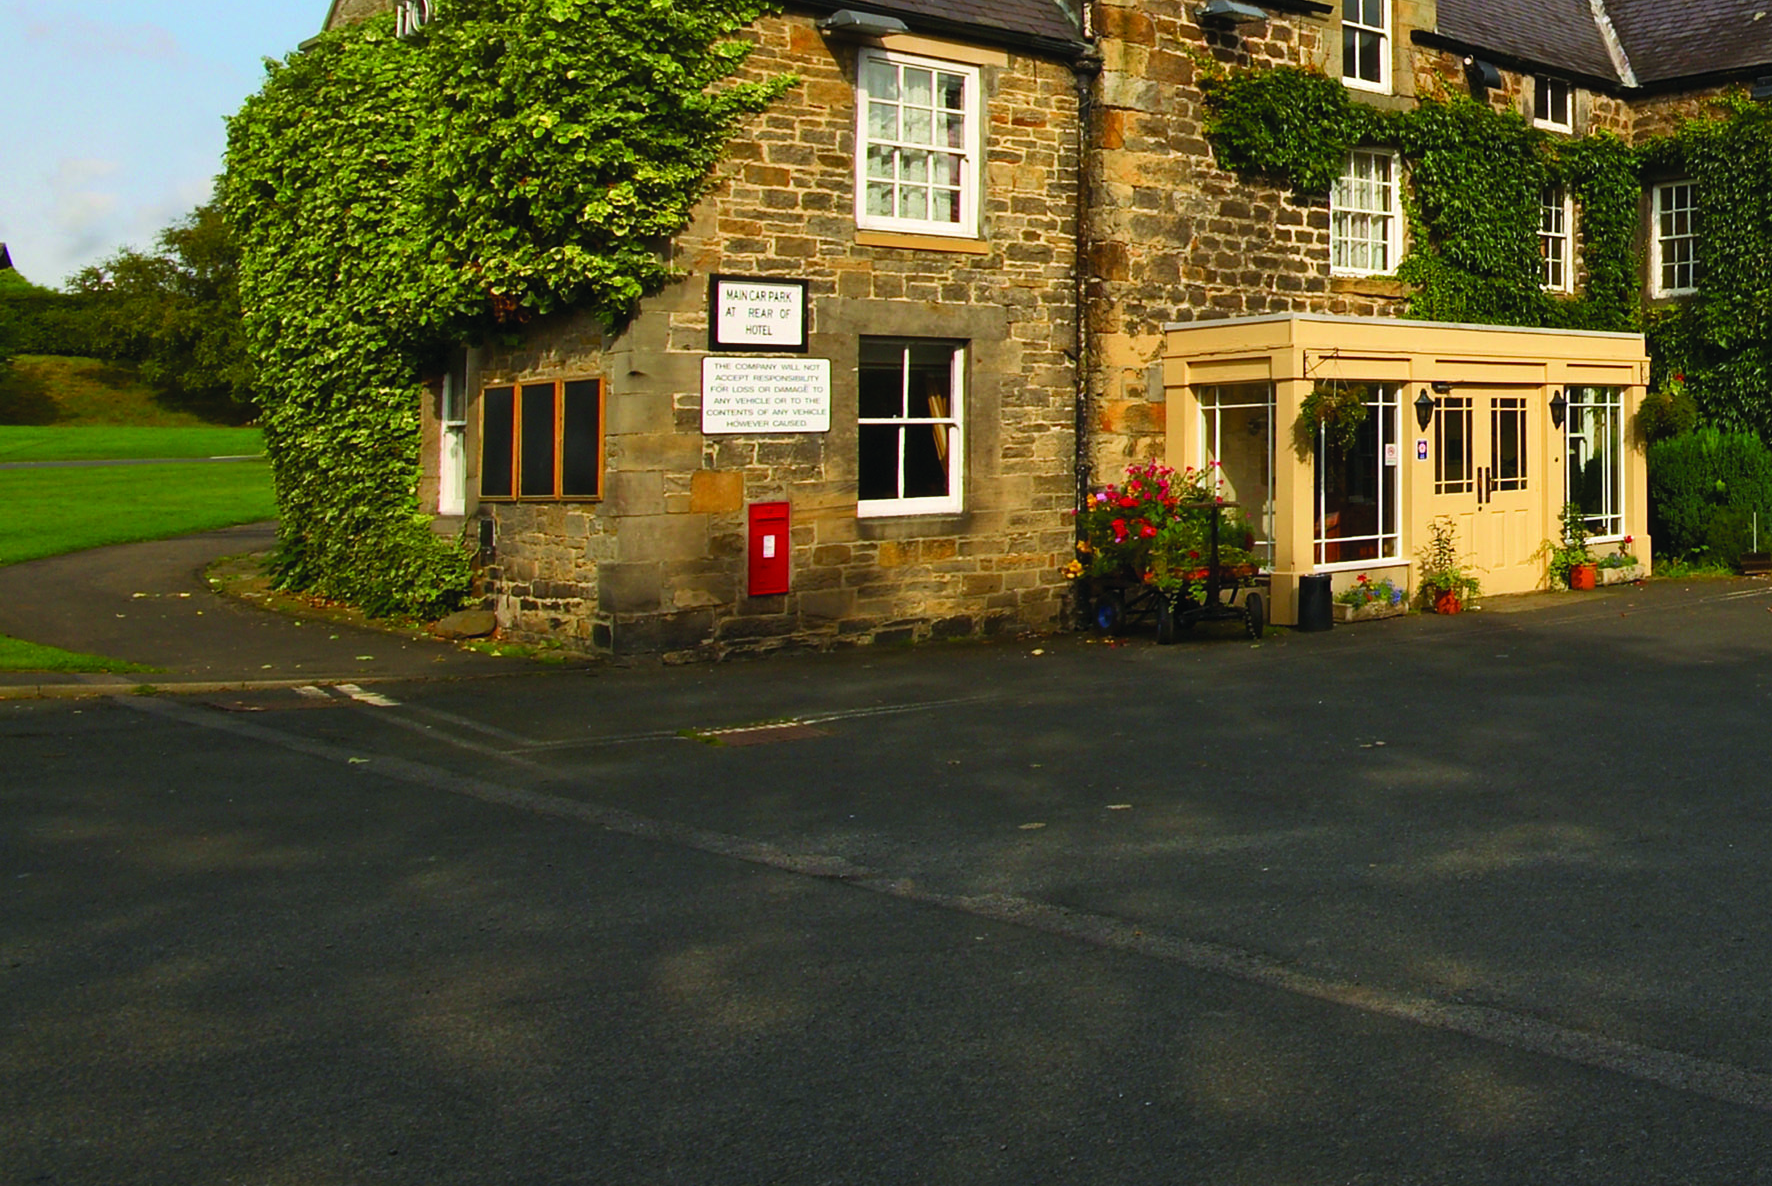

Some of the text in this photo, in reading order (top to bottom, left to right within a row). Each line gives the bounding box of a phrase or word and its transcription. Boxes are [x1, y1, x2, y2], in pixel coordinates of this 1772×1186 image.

[726, 289, 792, 303] MAIN CAR PARK
[725, 306, 791, 319] AT REAR OF
[745, 324, 773, 336] HOTEL
[781, 363, 800, 371] WILL
